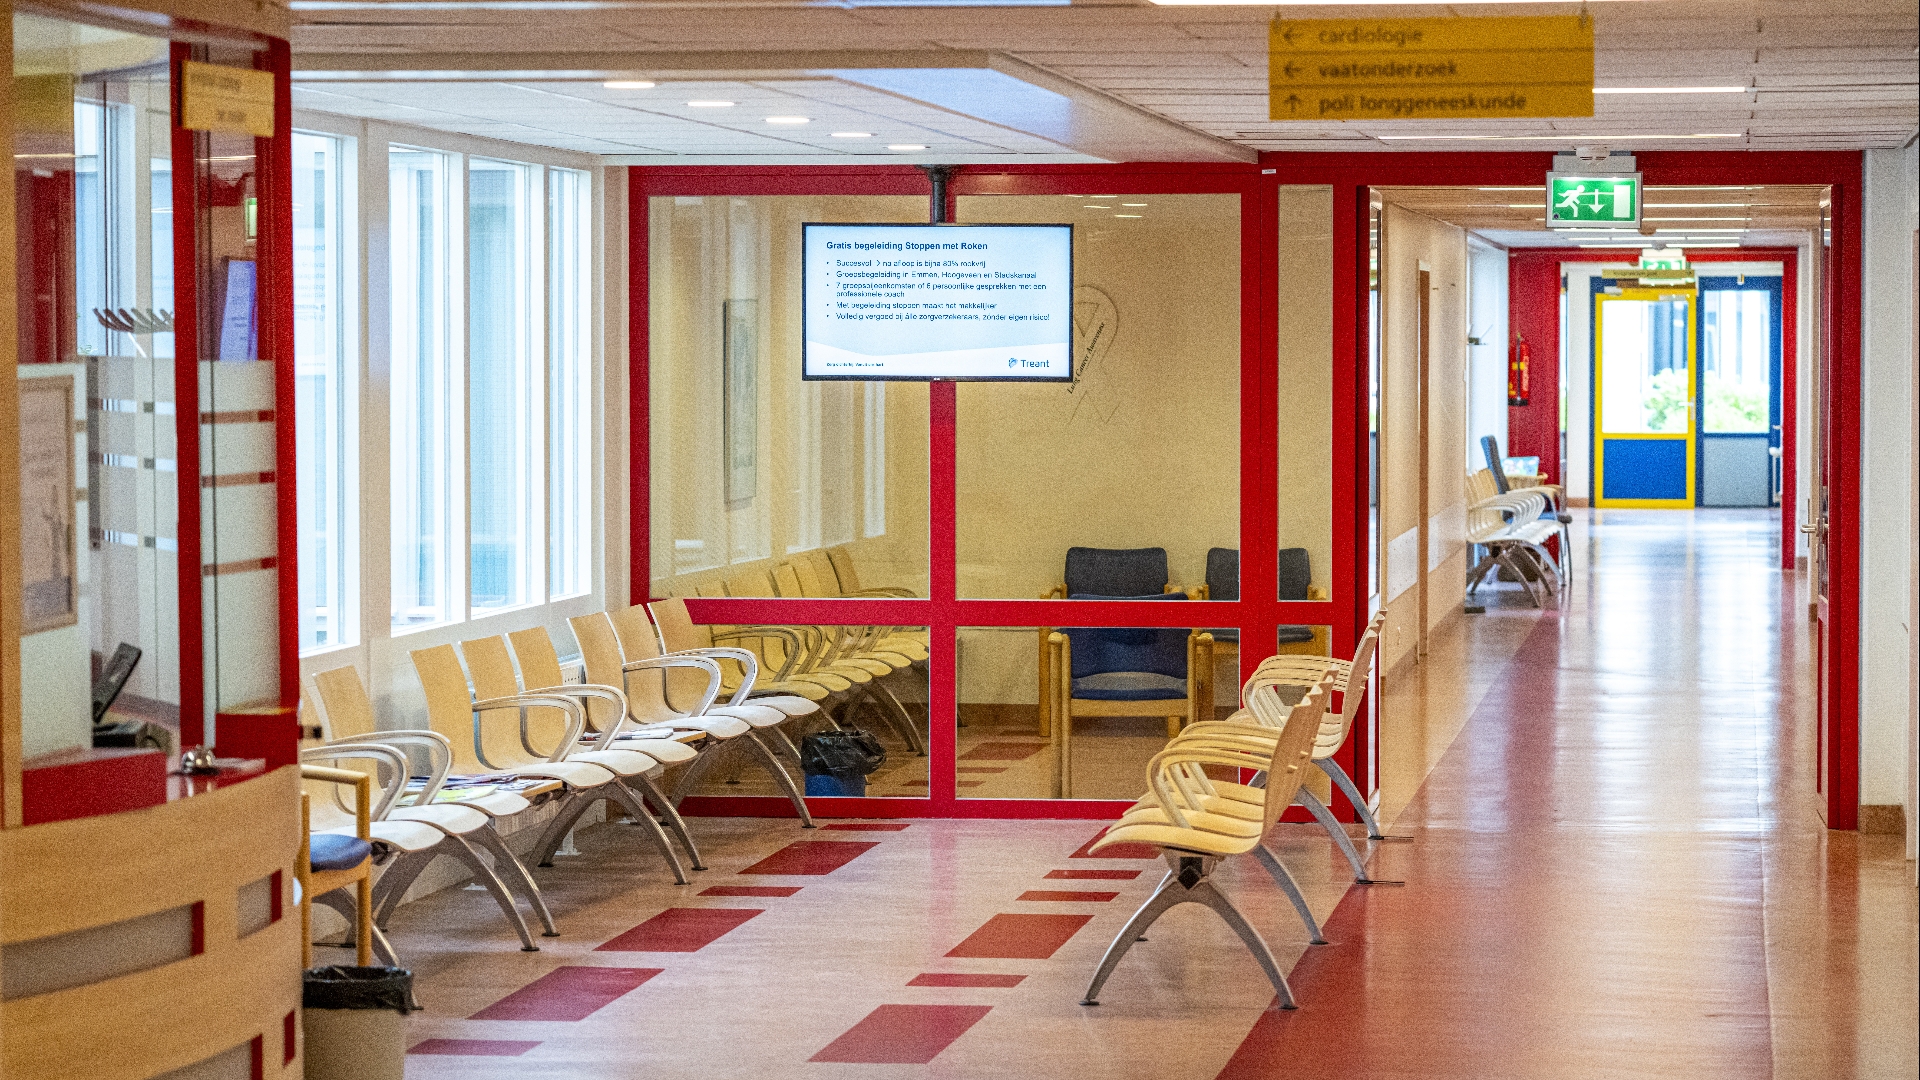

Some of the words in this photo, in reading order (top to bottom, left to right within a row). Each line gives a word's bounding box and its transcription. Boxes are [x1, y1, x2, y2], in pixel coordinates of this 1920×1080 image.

[1319, 27, 1423, 48] cardiologie
[1319, 61, 1457, 78] vaatonderzoek
[1319, 94, 1354, 116] poli
[1359, 93, 1527, 116] longgeneeskunde
[826, 241, 852, 250] Gratis
[854, 241, 903, 251] begeleiding
[905, 241, 941, 251] Stoppen
[942, 242, 959, 250] met
[960, 242, 988, 250] Roken
[836, 259, 872, 267] Succesvol
[893, 260, 915, 268] afloop
[924, 260, 941, 268] bijna
[960, 260, 986, 269] rookvrij
[836, 270, 901, 279] Groepsbegeleiding
[911, 271, 940, 279] Emmen,
[941, 271, 982, 280] Hoogeveen
[994, 271, 1037, 279] Stadskanaal
[836, 281, 841, 289] 7
[842, 281, 916, 290] groepsbijeenkomsten
[932, 282, 975, 291] persoonlijke
[976, 282, 1017, 291] gesprekken
[836, 290, 883, 298] professionele
[884, 290, 905, 298] coach
[836, 301, 850, 309] Met
[851, 301, 891, 310] begeleiding
[892, 302, 921, 310] stoppen
[959, 302, 998, 310] makkelijker
[836, 312, 864, 320] Volledig
[865, 312, 894, 321] vergoed
[895, 312, 904, 321] bij
[919, 312, 981, 321] zorgverzekeraars,
[1008, 313, 1028, 321] eigen
[1029, 313, 1050, 321] risico!
[1066, 377, 1080, 395] Lung
[1075, 353, 1089, 377] Cancer
[1086, 321, 1105, 355] Awareness
[1020, 359, 1050, 368] Treant
